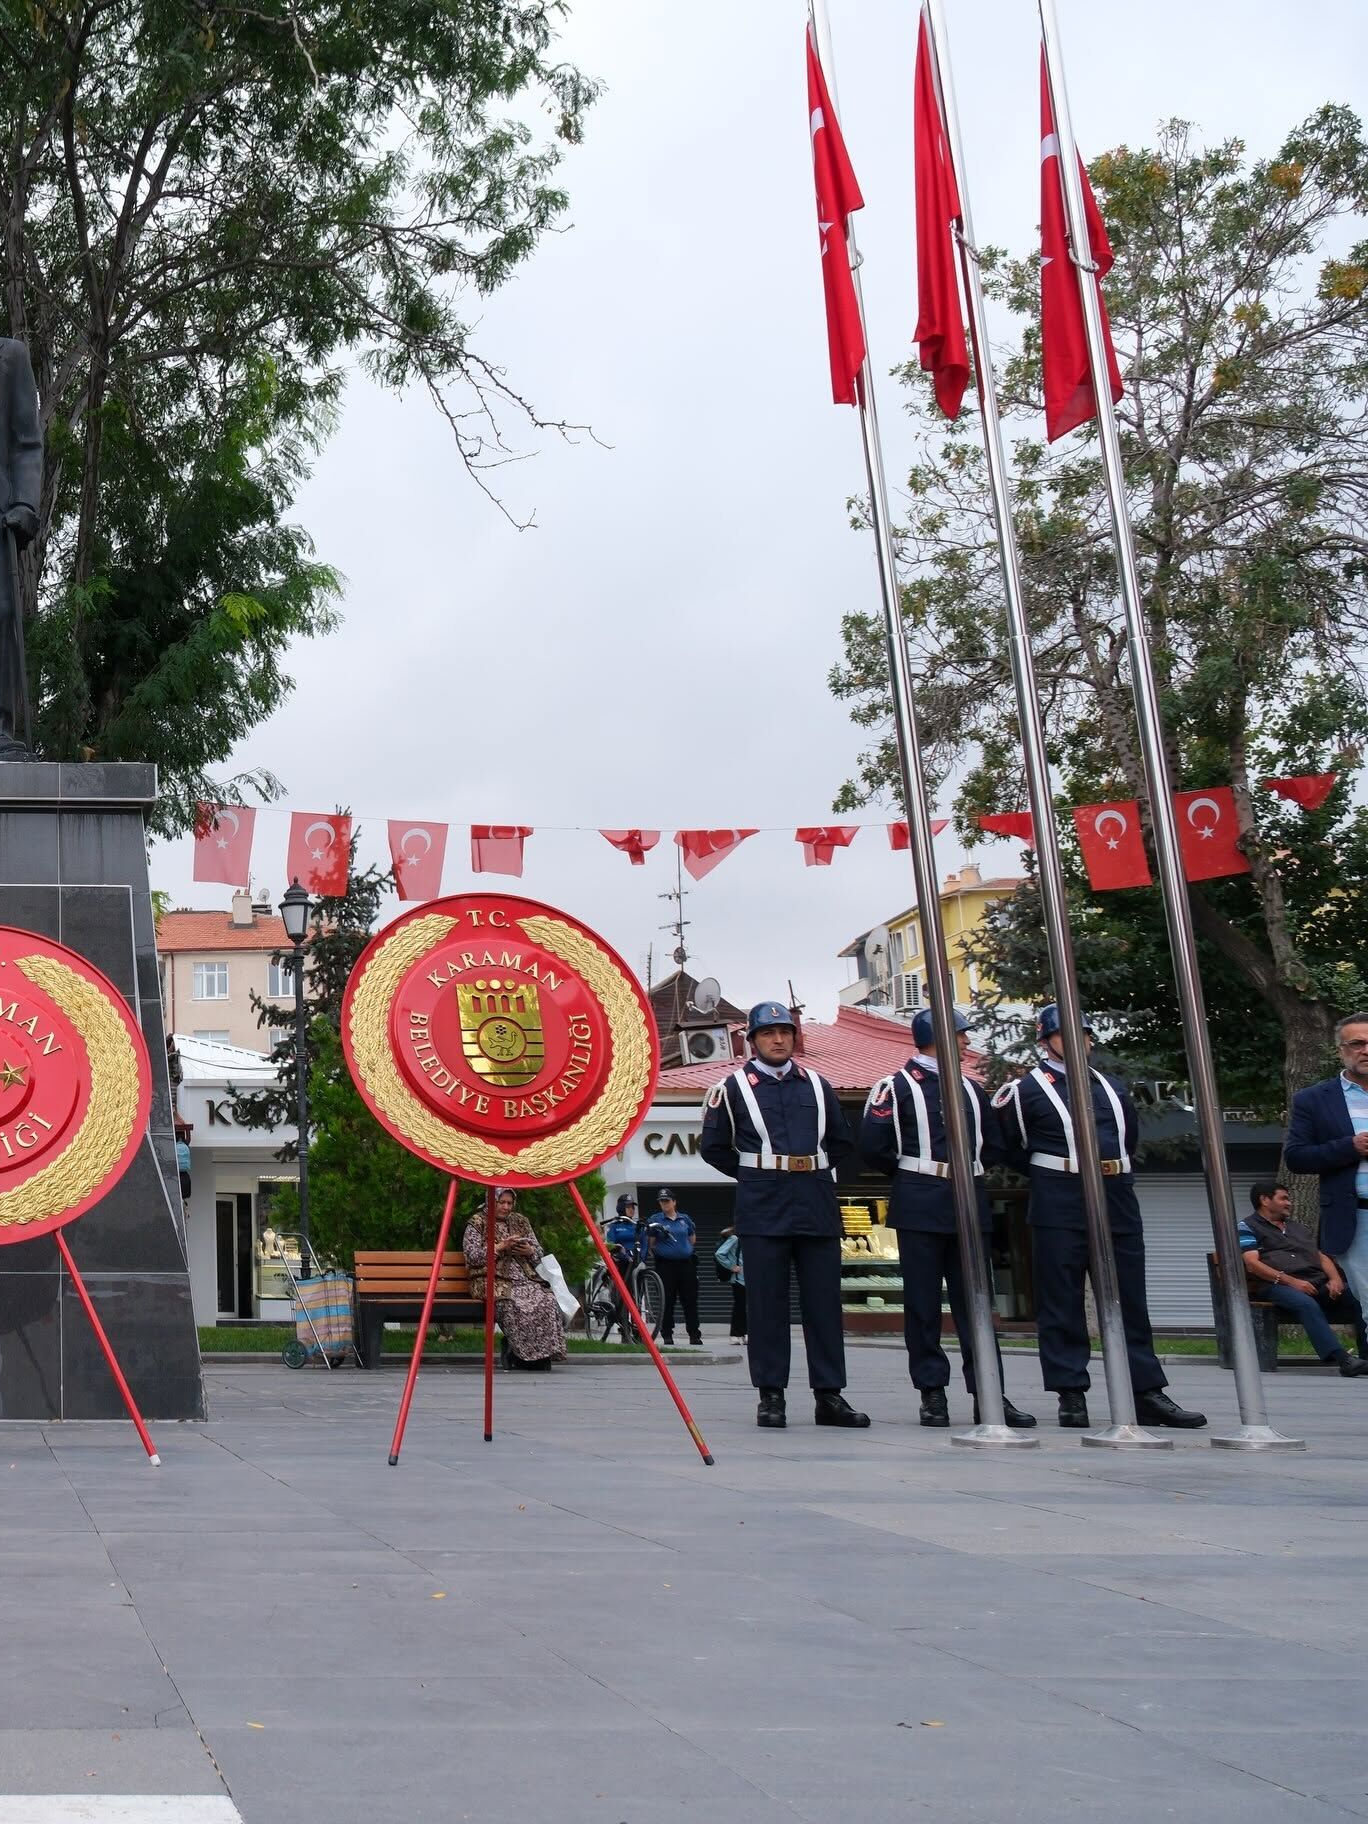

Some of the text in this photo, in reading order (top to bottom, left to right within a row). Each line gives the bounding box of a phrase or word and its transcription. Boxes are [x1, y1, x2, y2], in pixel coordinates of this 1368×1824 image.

[427, 950, 564, 991] KARAMAN
[409, 1010, 593, 1118] BELEDİYE BAŞKANLIĞI
